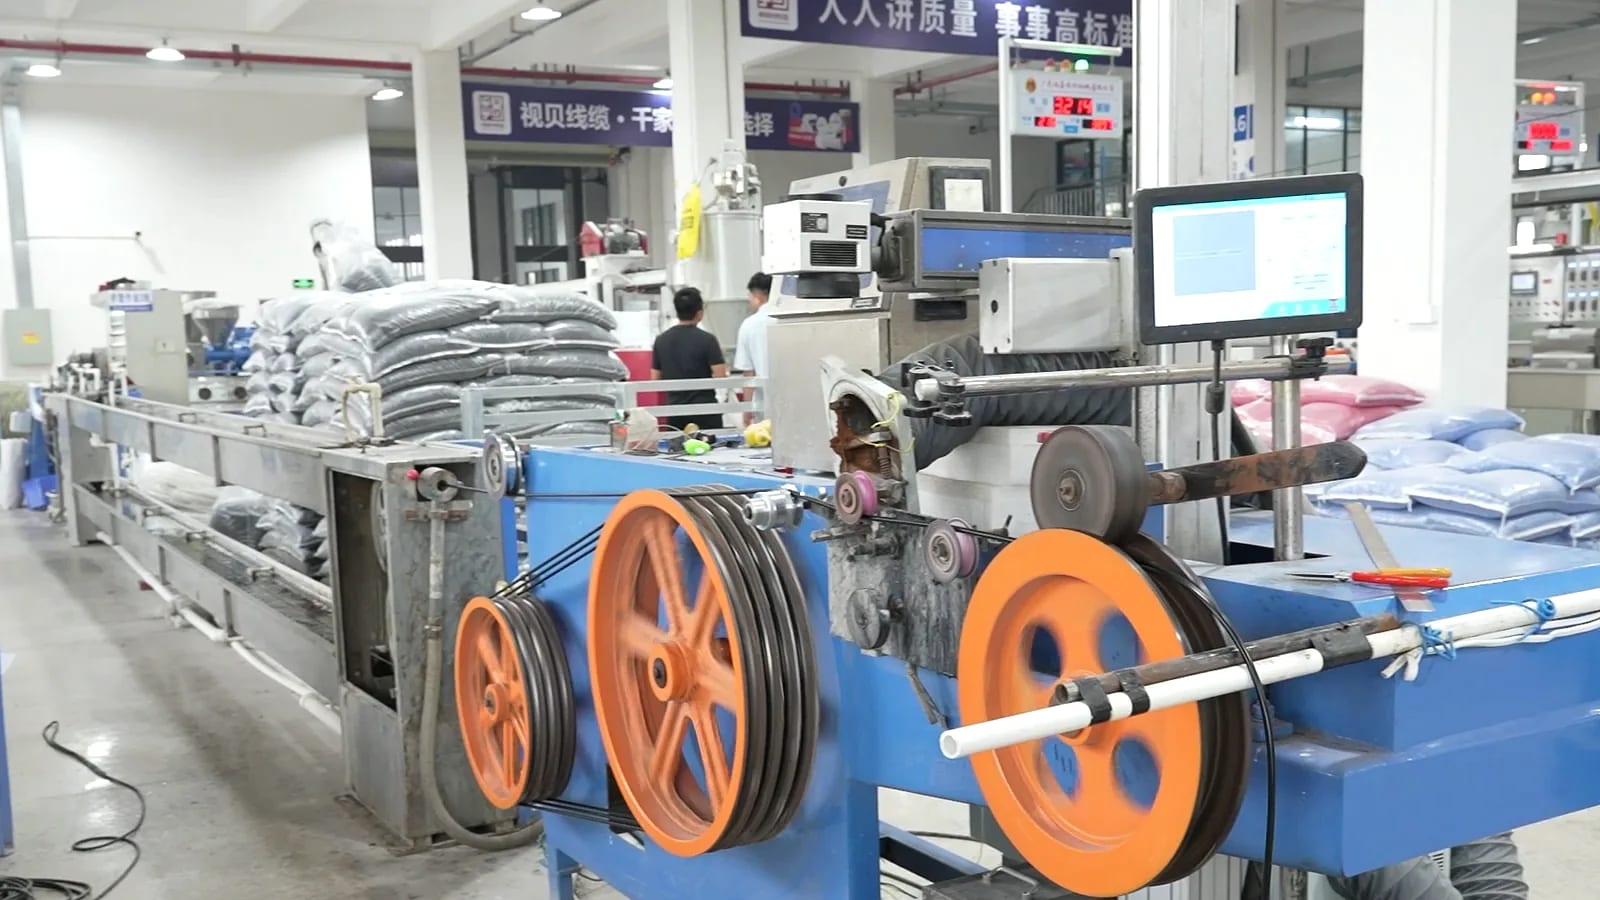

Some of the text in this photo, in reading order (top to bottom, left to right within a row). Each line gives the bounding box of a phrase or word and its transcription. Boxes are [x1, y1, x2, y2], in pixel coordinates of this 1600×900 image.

[818, 0, 1133, 49] 人人讲质量 事事高标准
